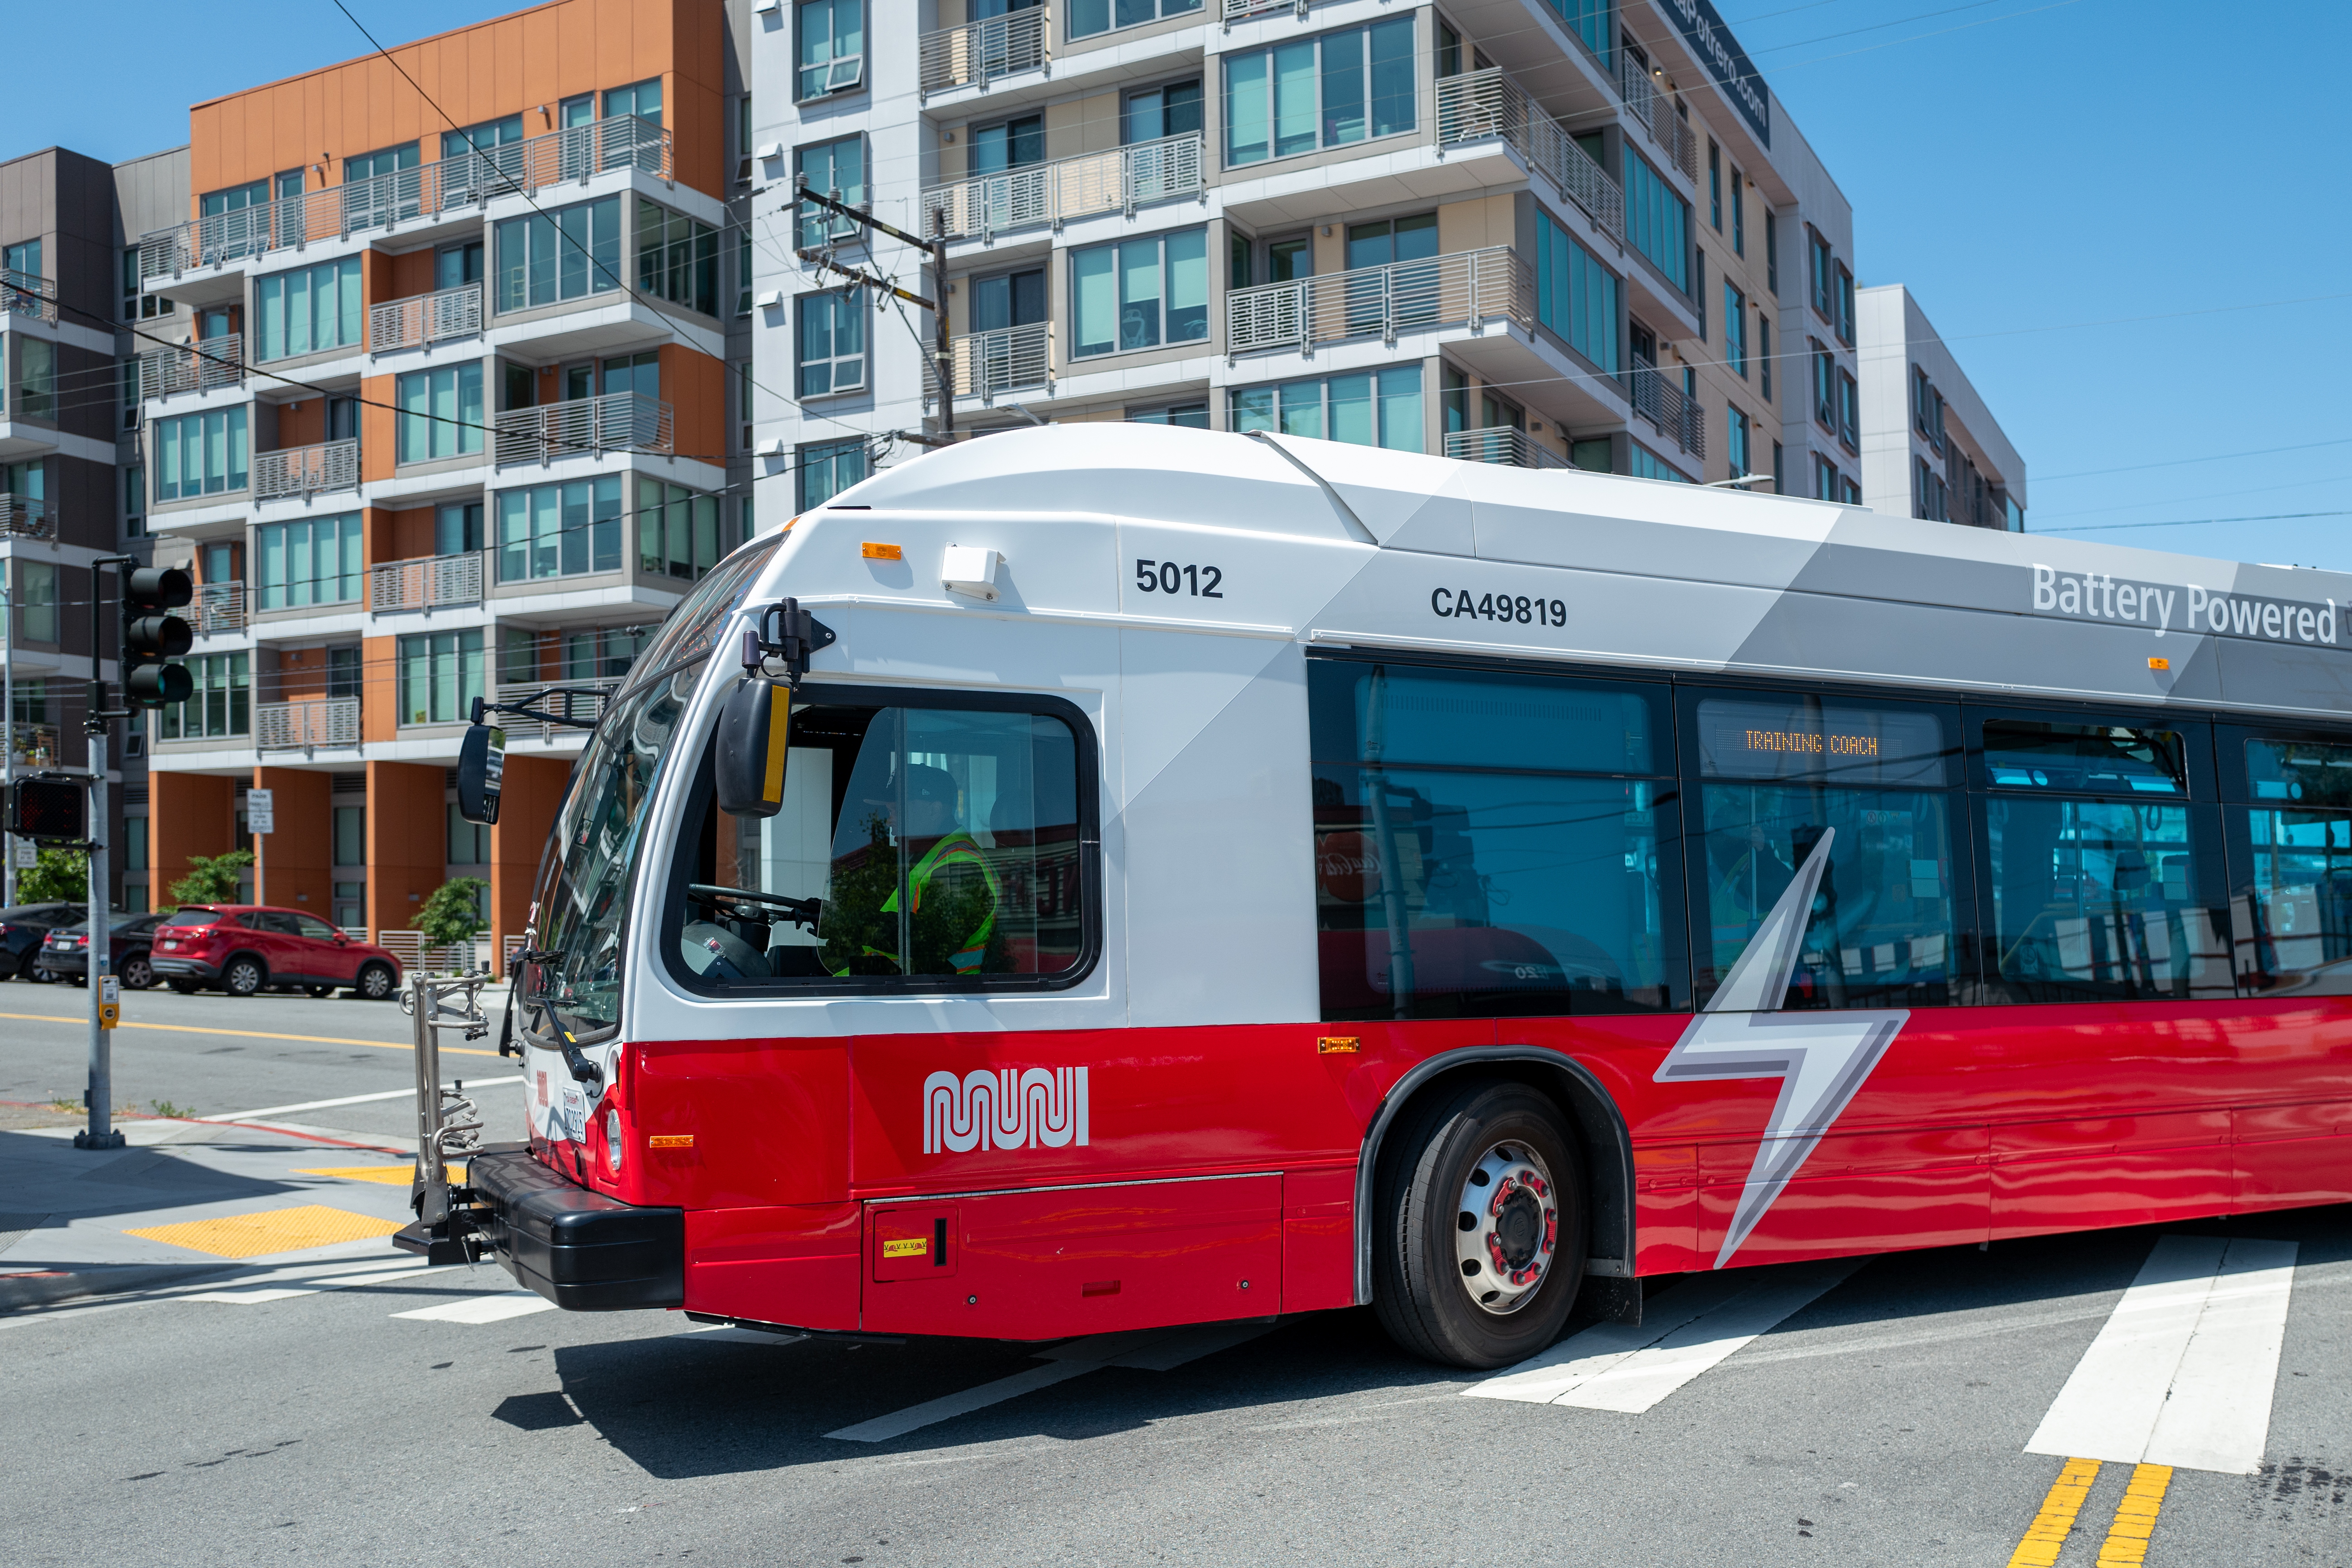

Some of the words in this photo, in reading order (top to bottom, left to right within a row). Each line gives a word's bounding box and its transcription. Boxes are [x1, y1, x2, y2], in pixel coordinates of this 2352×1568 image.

[1137, 559, 1223, 598] 5012
[1431, 587, 1566, 627] CA49819
[2032, 563, 2175, 638] Battery
[2187, 583, 2337, 644] Powered
[1746, 730, 1822, 752] TRAINING
[1830, 735, 1877, 755] COACH
